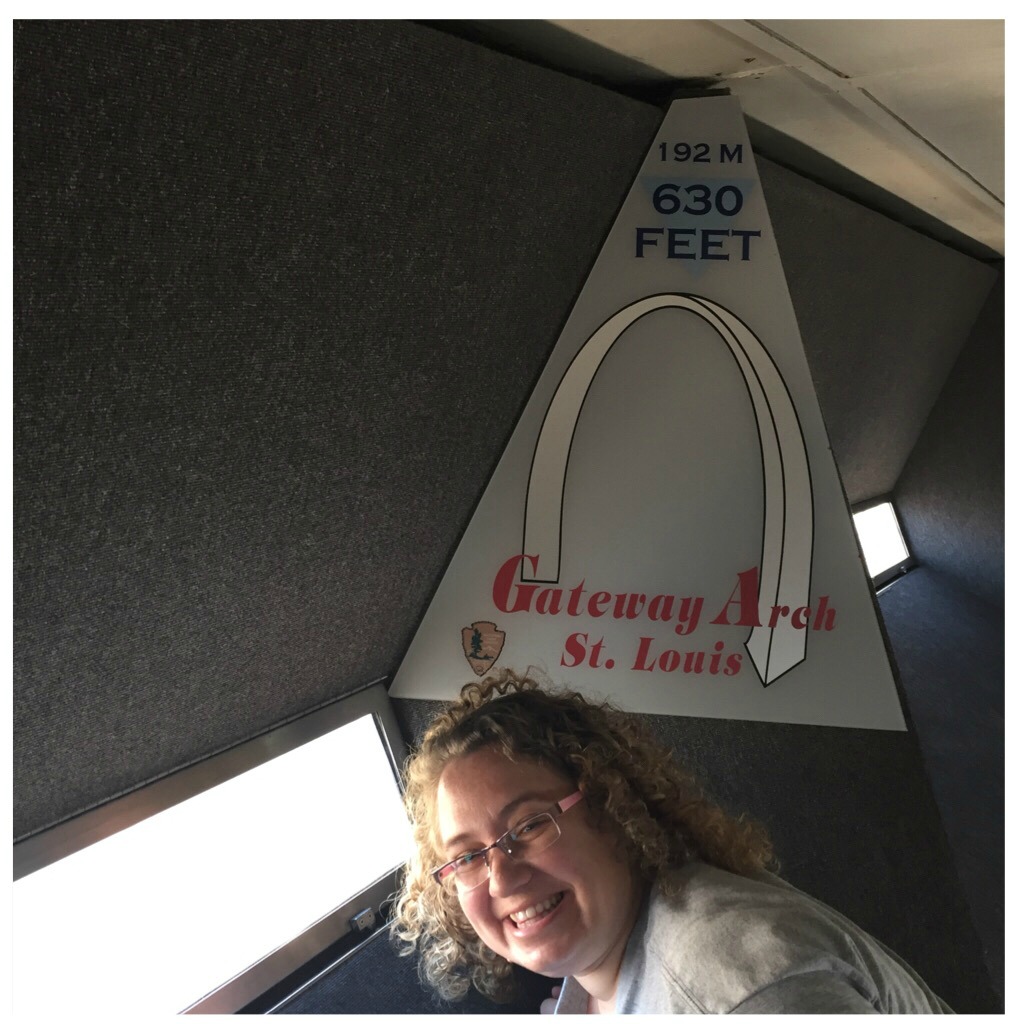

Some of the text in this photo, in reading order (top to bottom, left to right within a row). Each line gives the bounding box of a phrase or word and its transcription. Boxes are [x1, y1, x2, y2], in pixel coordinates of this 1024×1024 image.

[658, 141, 743, 164] 192 M
[652, 183, 744, 217] 630
[635, 228, 761, 262] FEET
[492, 554, 836, 634] Gateway Arch
[560, 632, 743, 676] St. Louis
